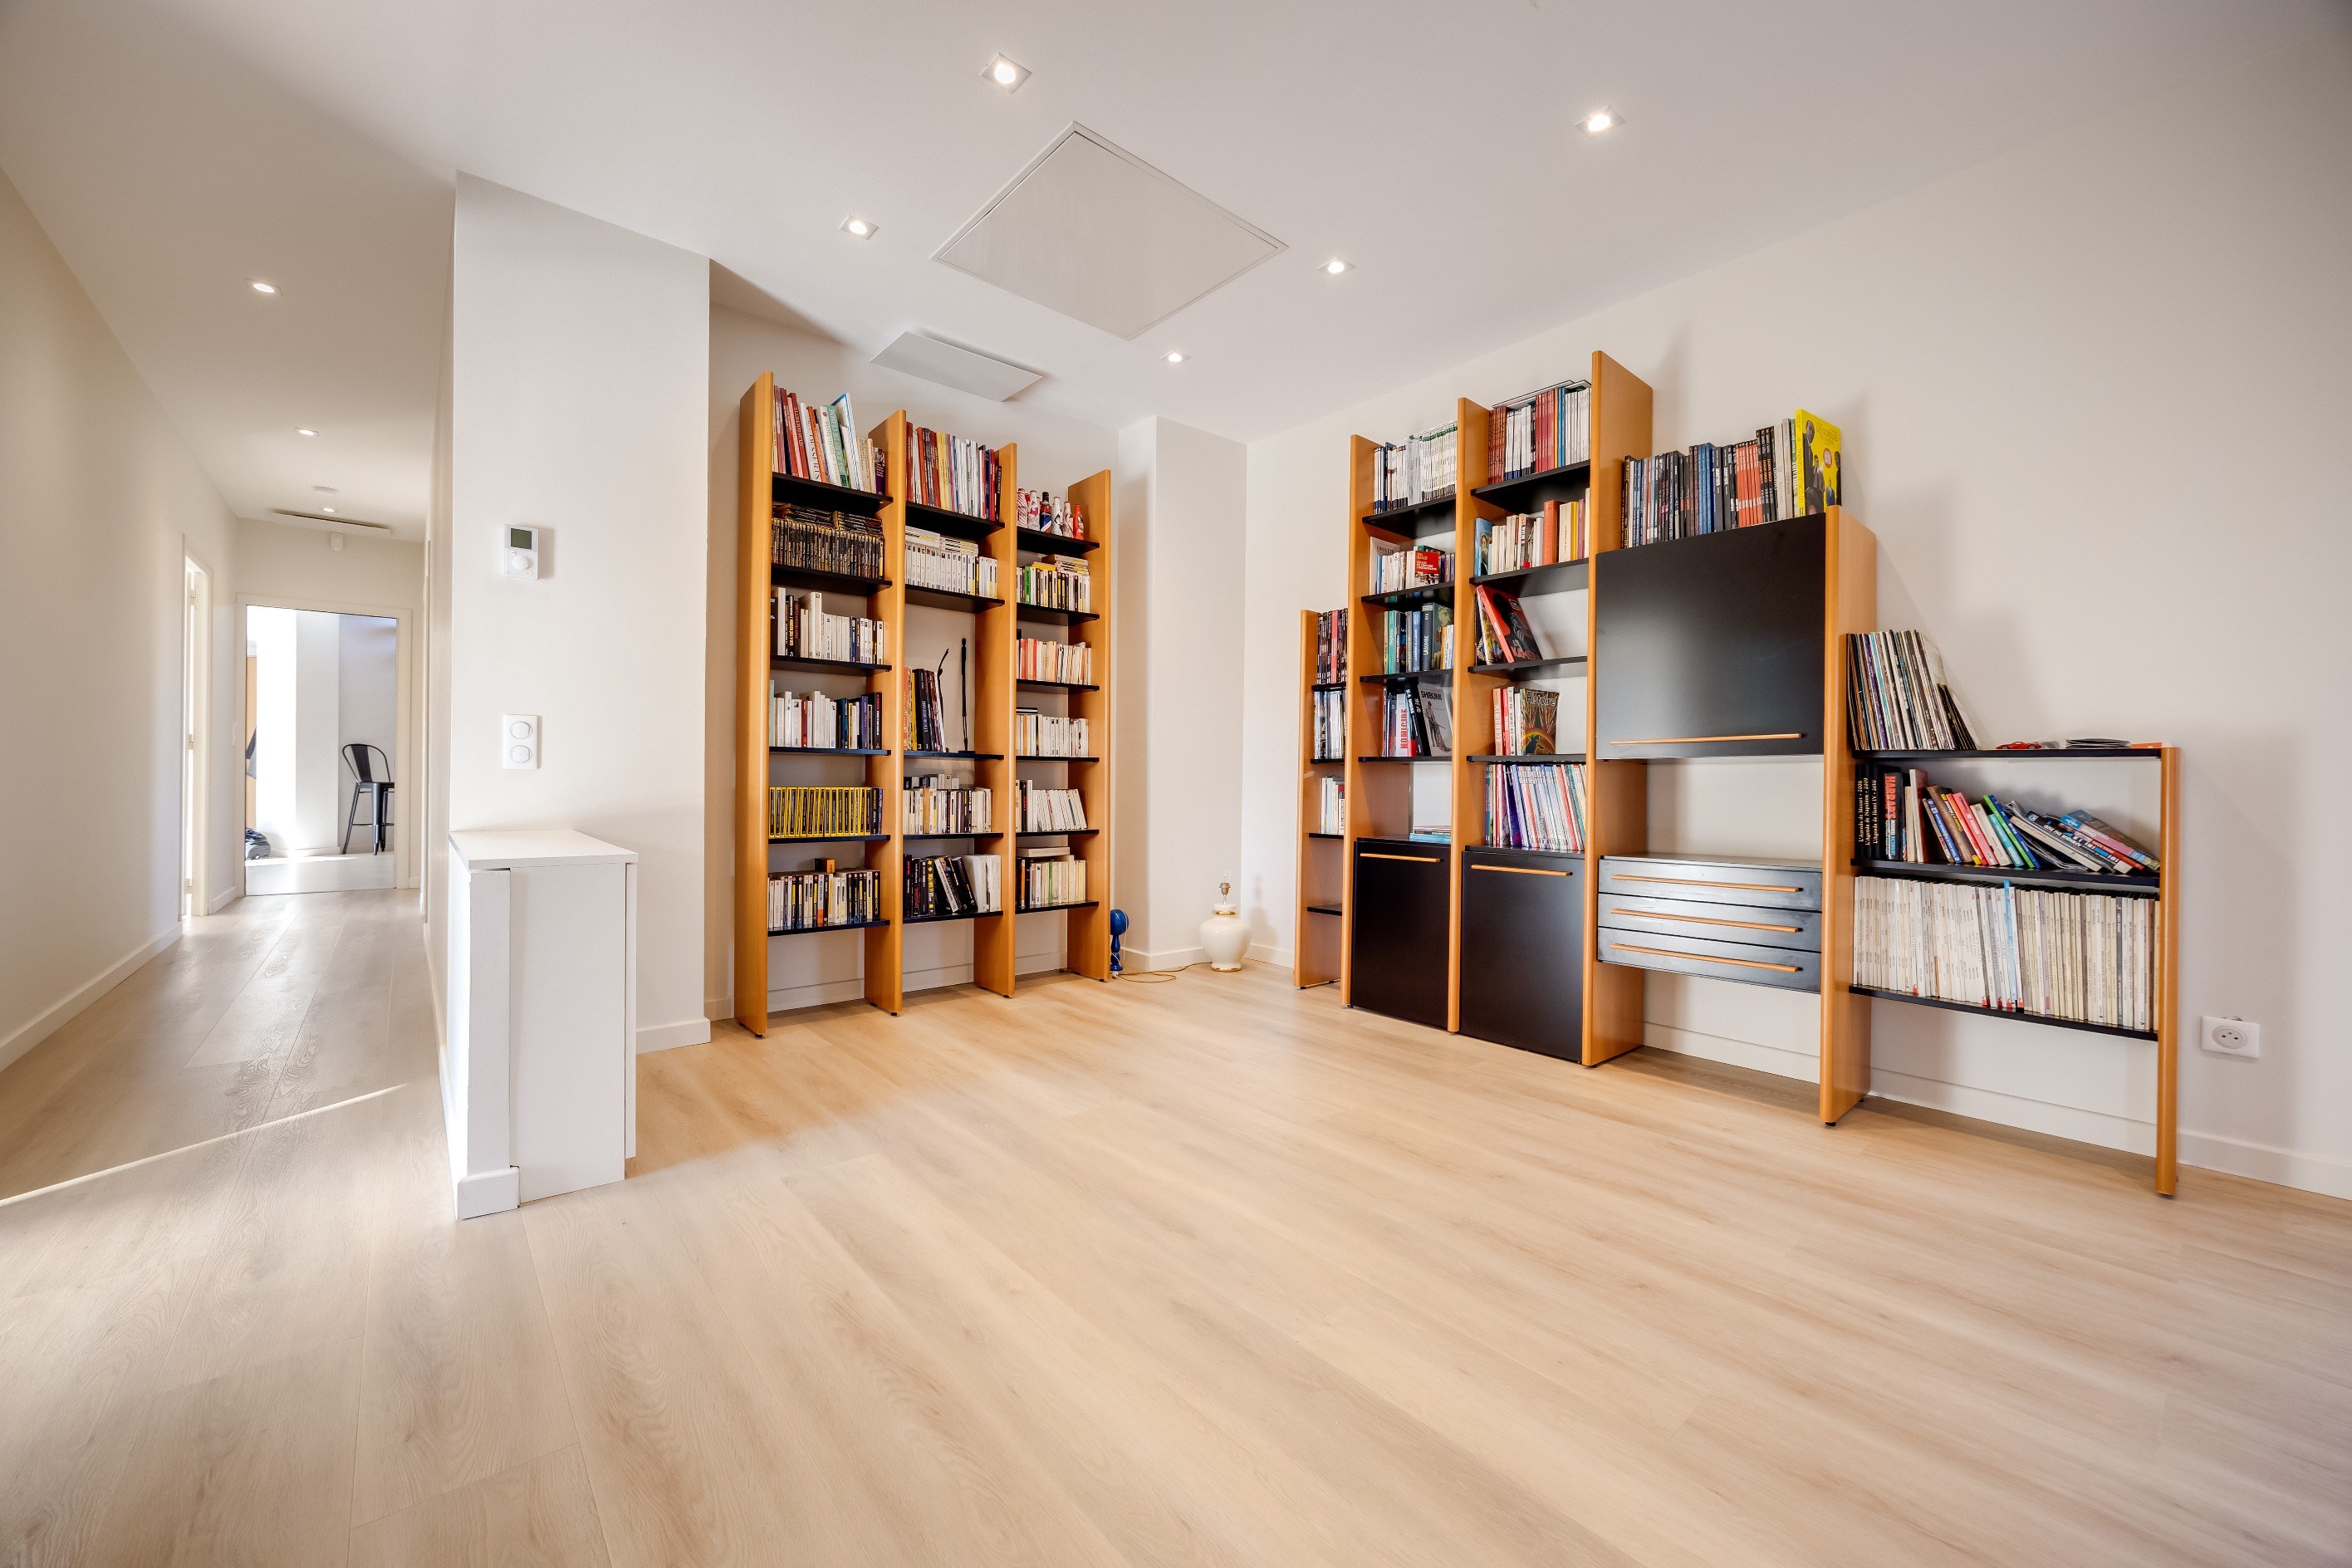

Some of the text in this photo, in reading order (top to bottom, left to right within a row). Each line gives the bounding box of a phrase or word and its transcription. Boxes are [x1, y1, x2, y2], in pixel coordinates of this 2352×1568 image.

[827, 408, 837, 431] CUISINE
[832, 432, 839, 440] DE
[834, 441, 842, 461] JOURS
[1526, 693, 1556, 706] Histoire
[1884, 776, 1896, 819] HARRAP'S
[2044, 824, 2054, 833] SUD
[2061, 833, 2082, 847] AFRIQUE
